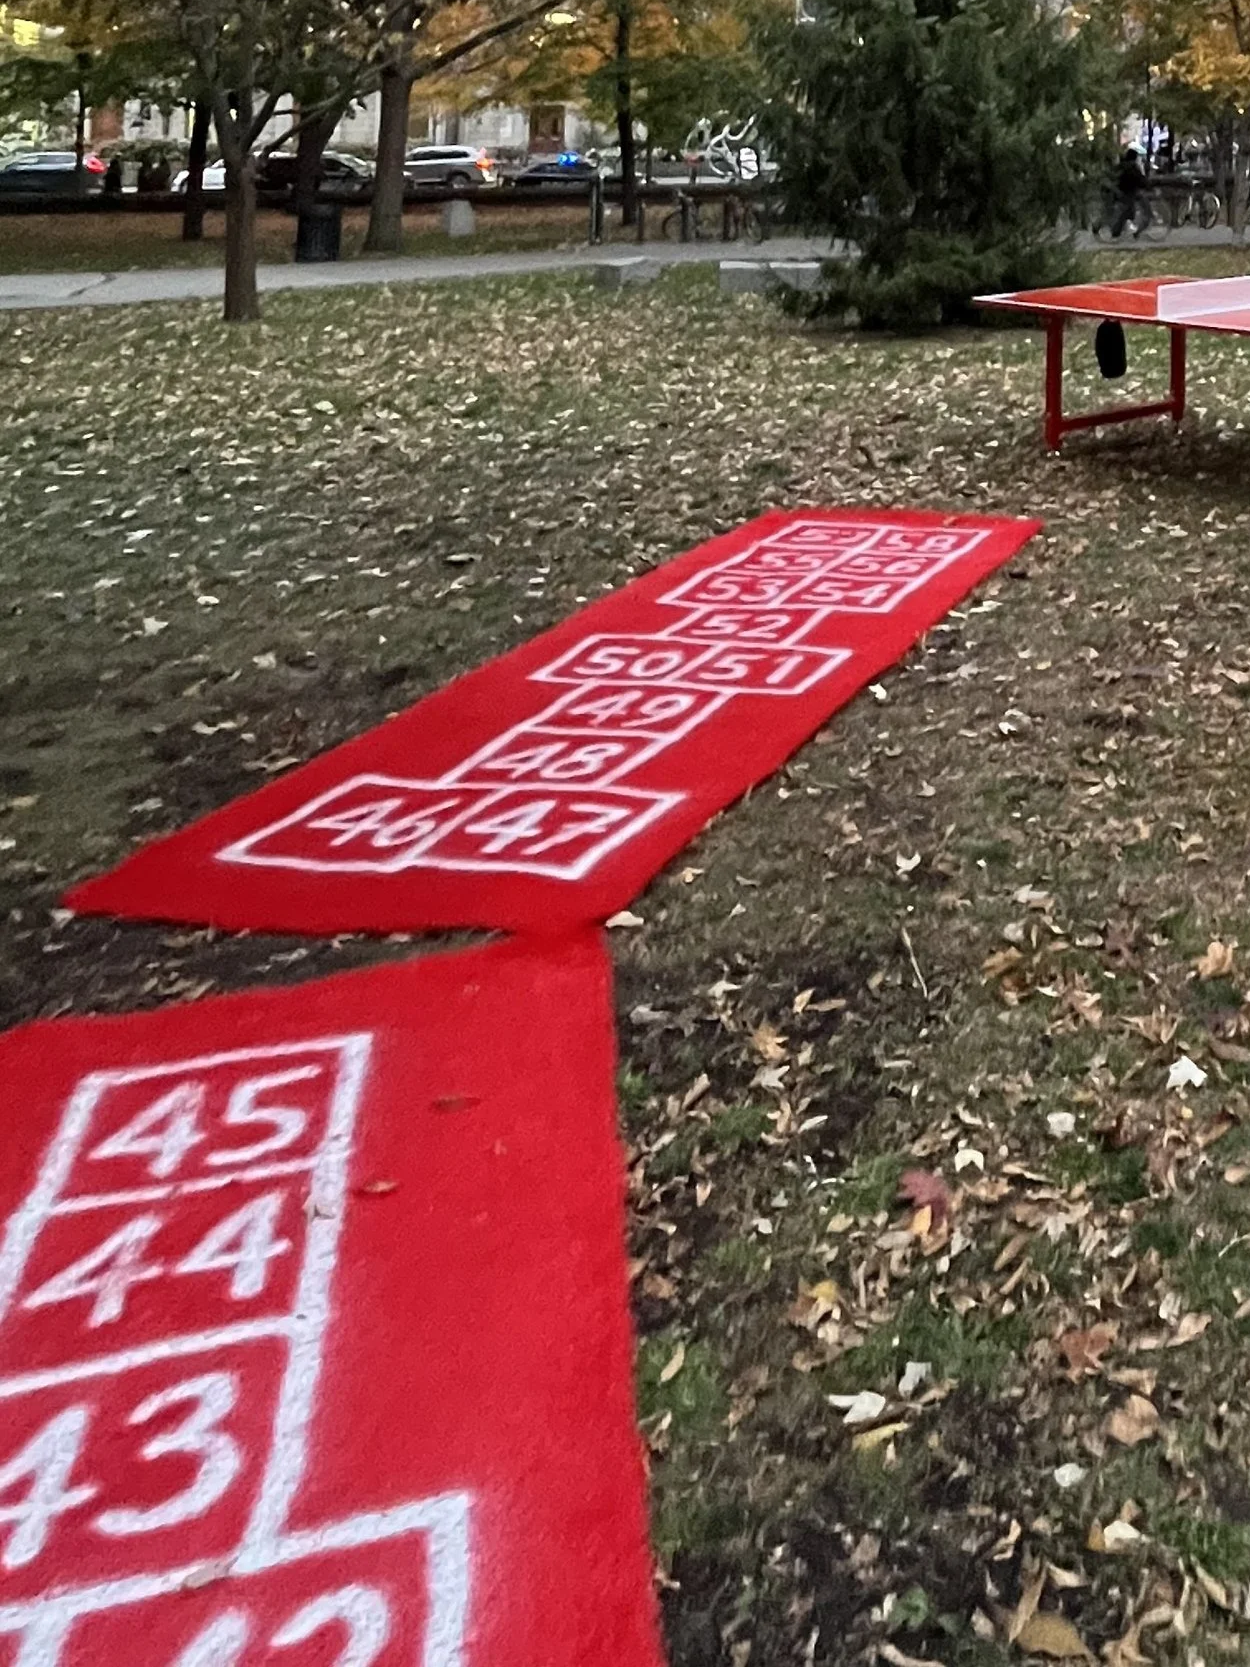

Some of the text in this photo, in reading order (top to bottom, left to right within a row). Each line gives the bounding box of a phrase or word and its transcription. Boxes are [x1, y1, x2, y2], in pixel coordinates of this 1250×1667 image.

[878, 533, 960, 552] 58
[744, 552, 834, 571] 55
[839, 556, 928, 574] 56
[698, 577, 785, 604] 53
[800, 582, 892, 606] 54
[690, 613, 790, 639] 52
[572, 646, 683, 679] 50
[698, 653, 804, 684] 51
[567, 689, 697, 728] 49
[482, 742, 627, 780] 48
[307, 797, 461, 848] 46
[465, 799, 632, 857] 47
[90, 1063, 324, 1178] 45
[21, 1192, 292, 1329] 44
[0, 1372, 242, 1569] 43
